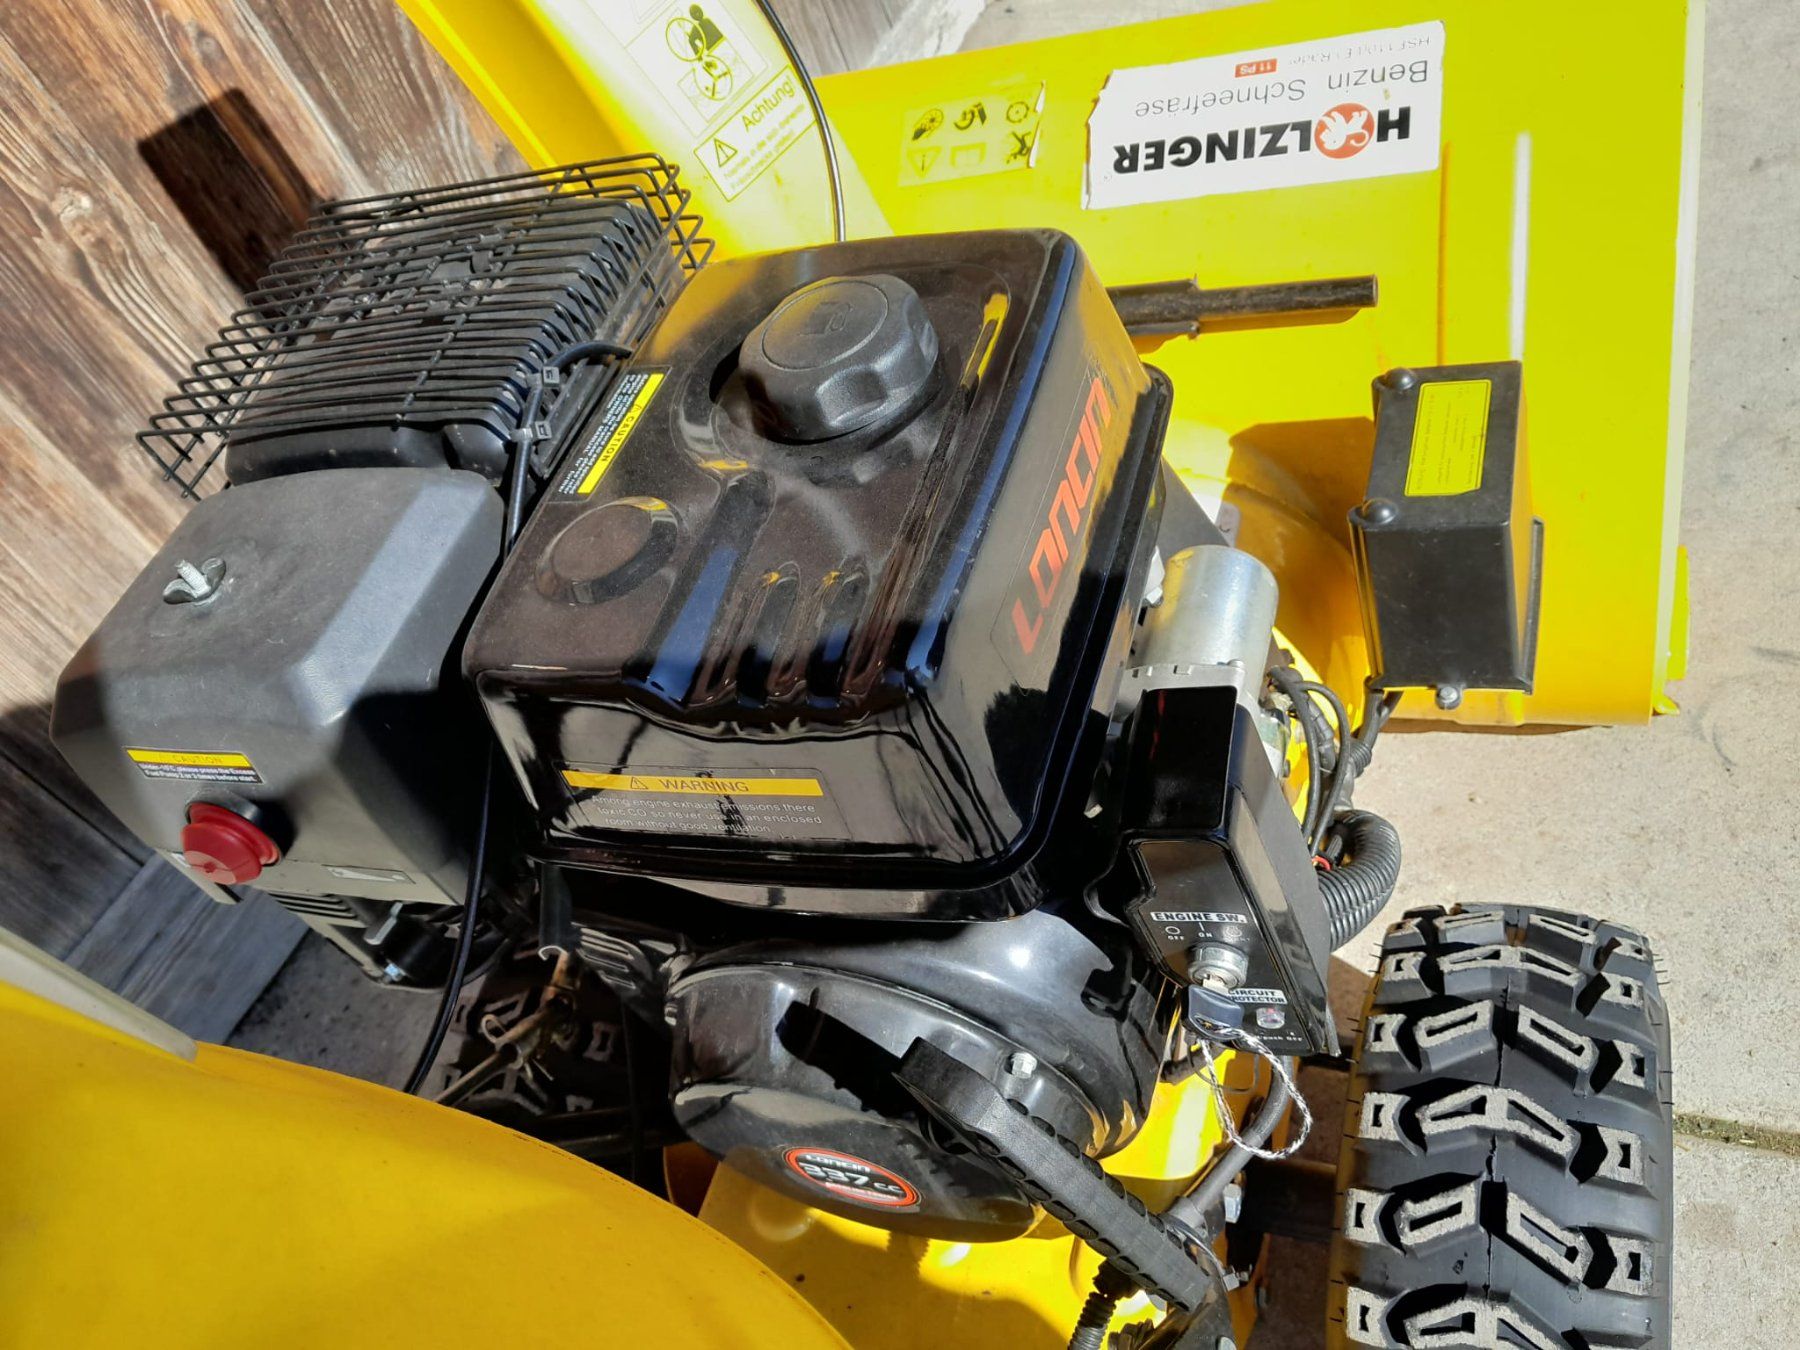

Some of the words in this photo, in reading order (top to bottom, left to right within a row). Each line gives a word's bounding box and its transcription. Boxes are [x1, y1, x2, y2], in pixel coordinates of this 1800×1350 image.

[1240, 64, 1256, 75] PS
[1327, 60, 1428, 94] Benzin
[1135, 79, 1306, 118] Schneefräse
[600, 415, 635, 462] CAUTION
[658, 779, 749, 793] WARNING
[592, 795, 631, 808] Among
[633, 799, 670, 809] engine
[673, 799, 719, 810] exhaust
[720, 801, 781, 812] emissions
[783, 803, 815, 813] there
[597, 806, 626, 816] toxic
[627, 808, 647, 817] CO
[668, 810, 701, 819] never
[763, 814, 822, 824] enclosed
[605, 818, 633, 826] room
[636, 819, 677, 829] without
[679, 822, 708, 831] good
[1155, 911, 1213, 921] ENGINE
[798, 1161, 870, 1187] 337
